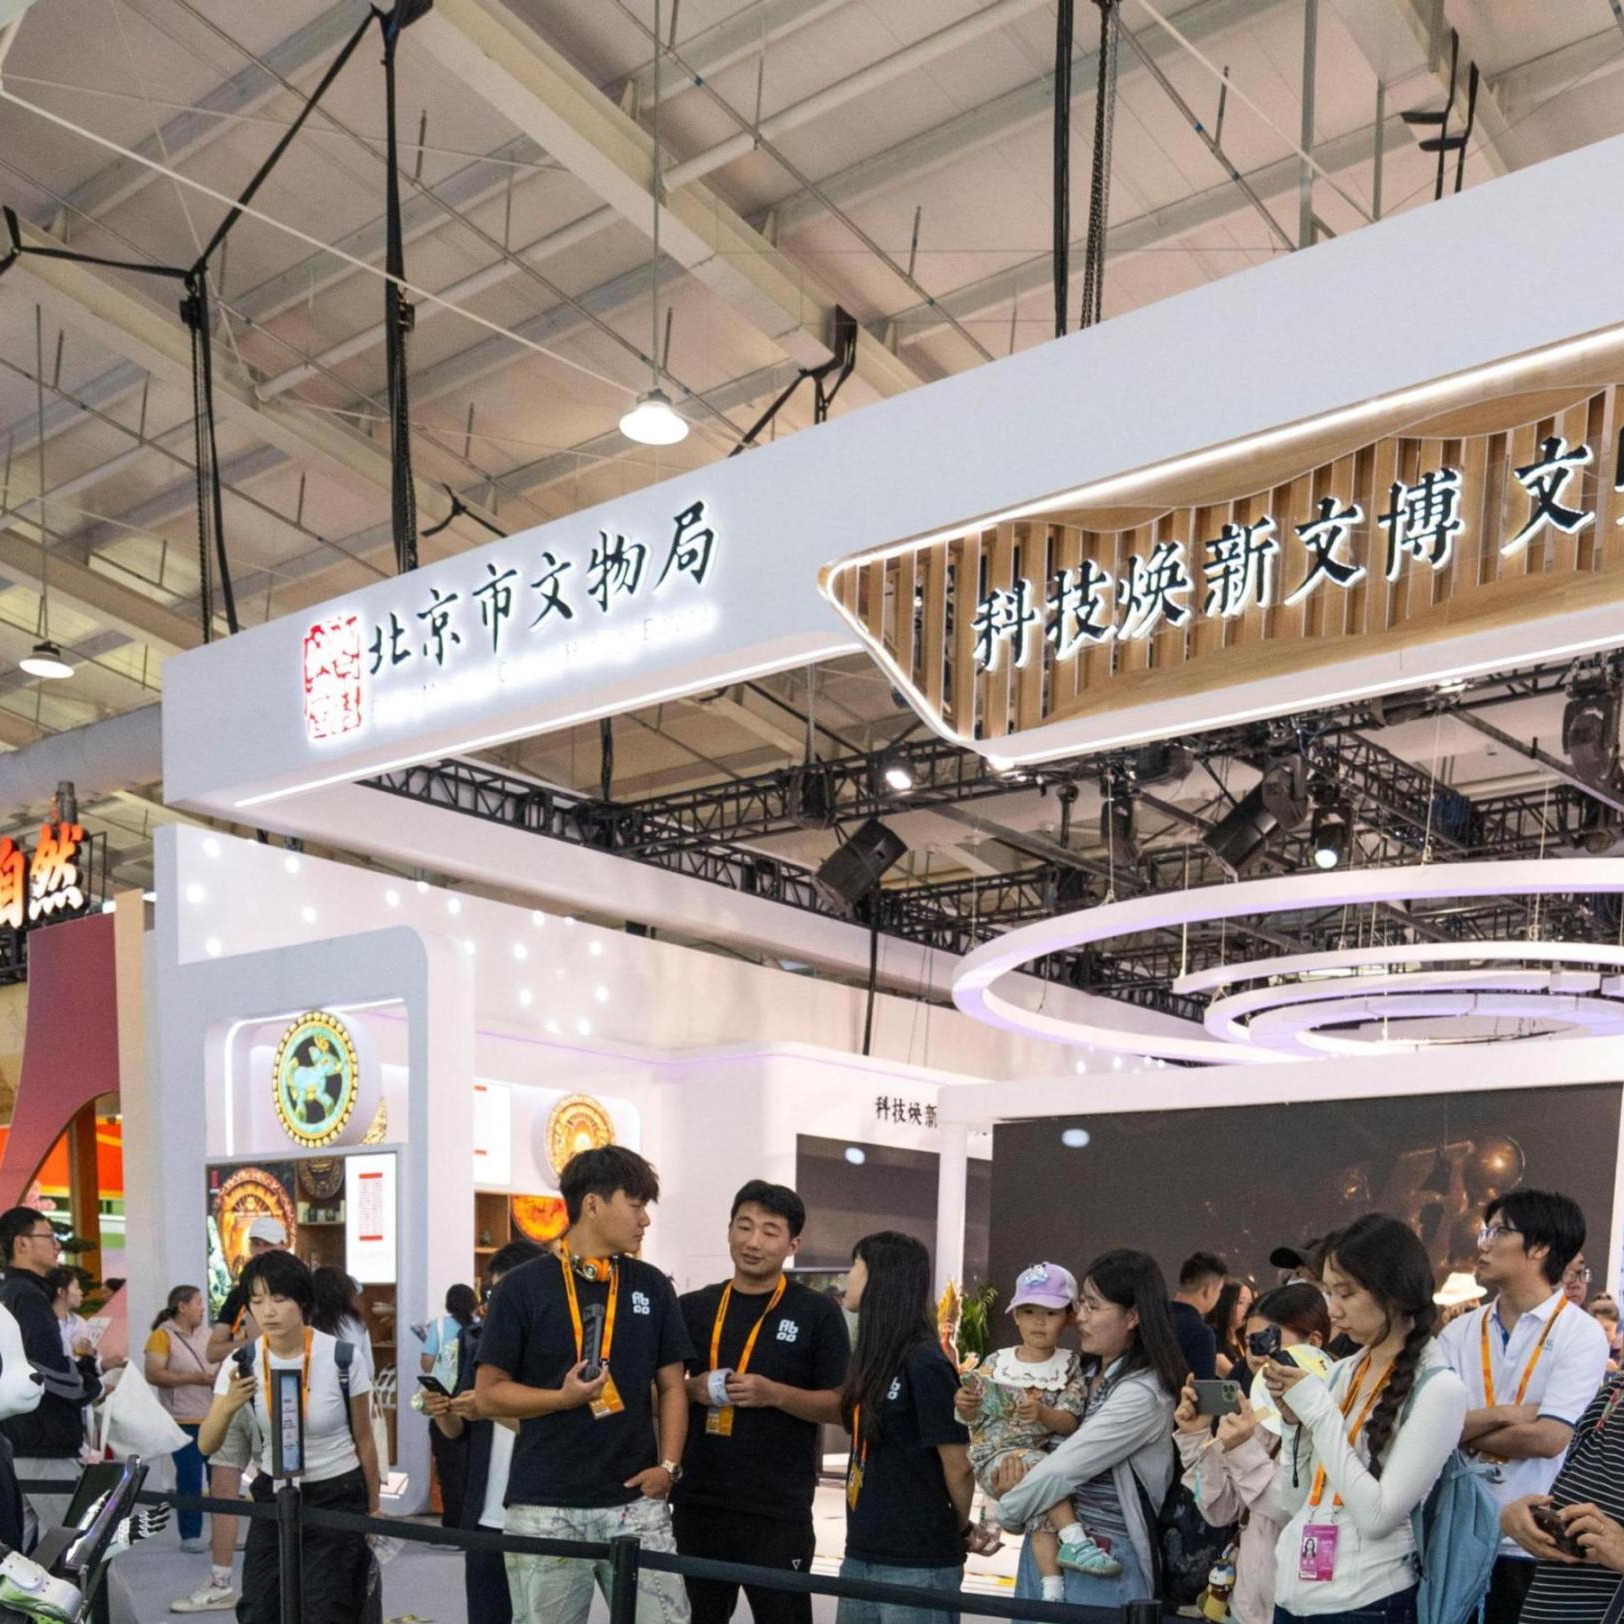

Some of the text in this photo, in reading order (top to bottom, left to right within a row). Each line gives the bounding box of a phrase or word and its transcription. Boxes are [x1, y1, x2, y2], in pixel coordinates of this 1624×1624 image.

[368, 500, 721, 676] 北京市文物局
[972, 467, 1467, 672] 科技焕新文博
